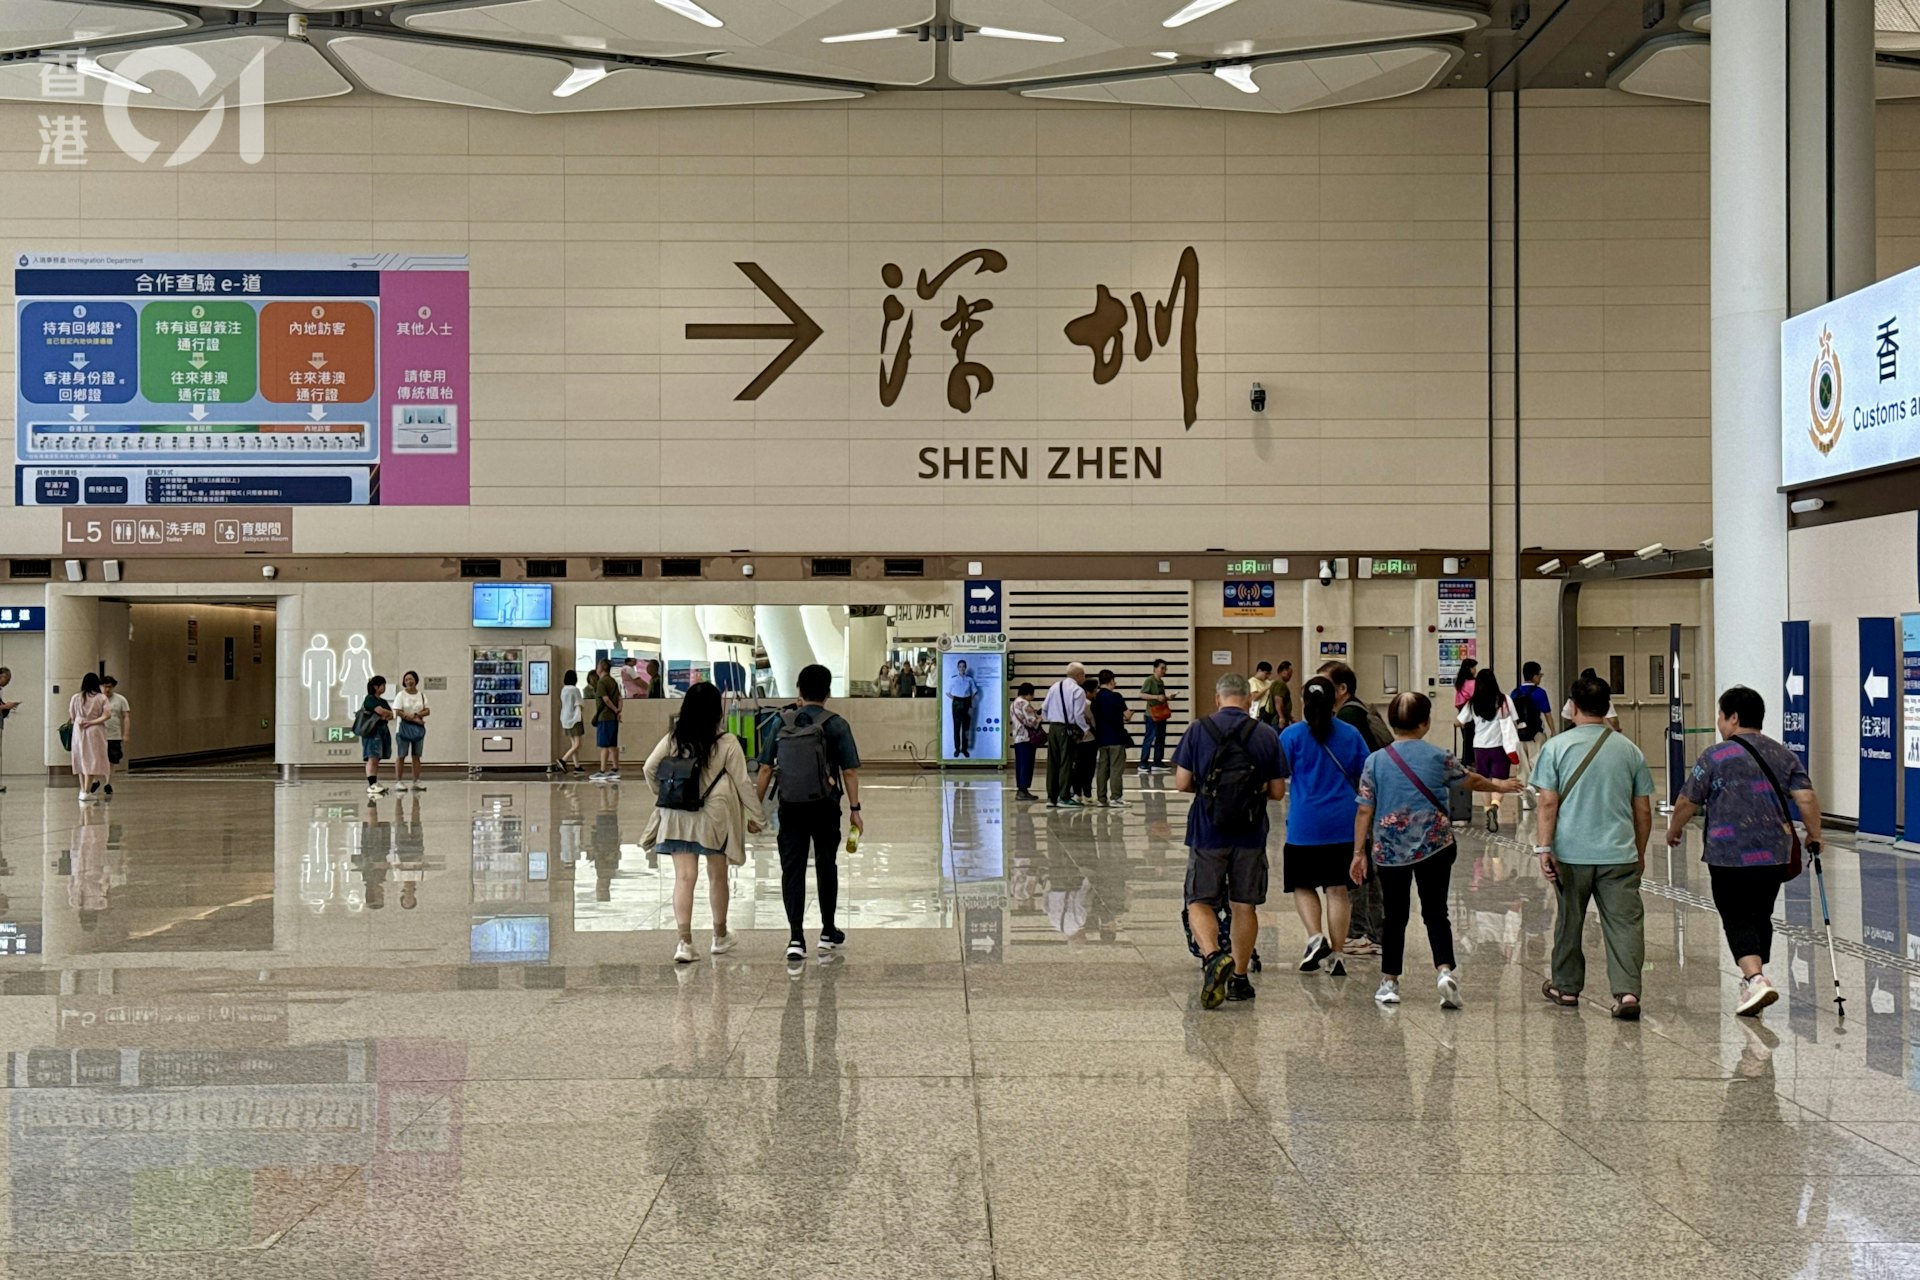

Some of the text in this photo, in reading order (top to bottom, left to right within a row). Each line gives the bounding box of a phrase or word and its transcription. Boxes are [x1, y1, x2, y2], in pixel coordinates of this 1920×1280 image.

[68, 257, 106, 265] Immigration
[107, 257, 144, 265] Department
[135, 273, 262, 293] 合作查驗 e-道
[155, 320, 242, 335] 持有逗留簽注
[396, 322, 453, 336] 其他人士
[177, 338, 220, 352] 通行證
[1876, 315, 1900, 385] 香
[43, 371, 116, 386] 香港身份證
[171, 371, 228, 386] 往來港澳
[289, 371, 346, 386] 往來港澳
[404, 370, 447, 384] 請使用
[58, 388, 102, 402] 回鄉證
[178, 388, 221, 402] 通行證
[296, 388, 339, 402] 通行證
[1853, 401, 1907, 432] Customs
[917, 446, 1162, 480] SHEN ZHEN
[66, 521, 102, 543] L5
[166, 522, 206, 536] 洗手間
[241, 522, 281, 536] 育嬰間
[1257, 563, 1272, 572] EXIT
[1403, 563, 1417, 572] EXIT
[1783, 711, 1805, 733] 往深圳
[1861, 716, 1891, 739] 往深圳
[1861, 747, 1892, 760] To Shenzhen
